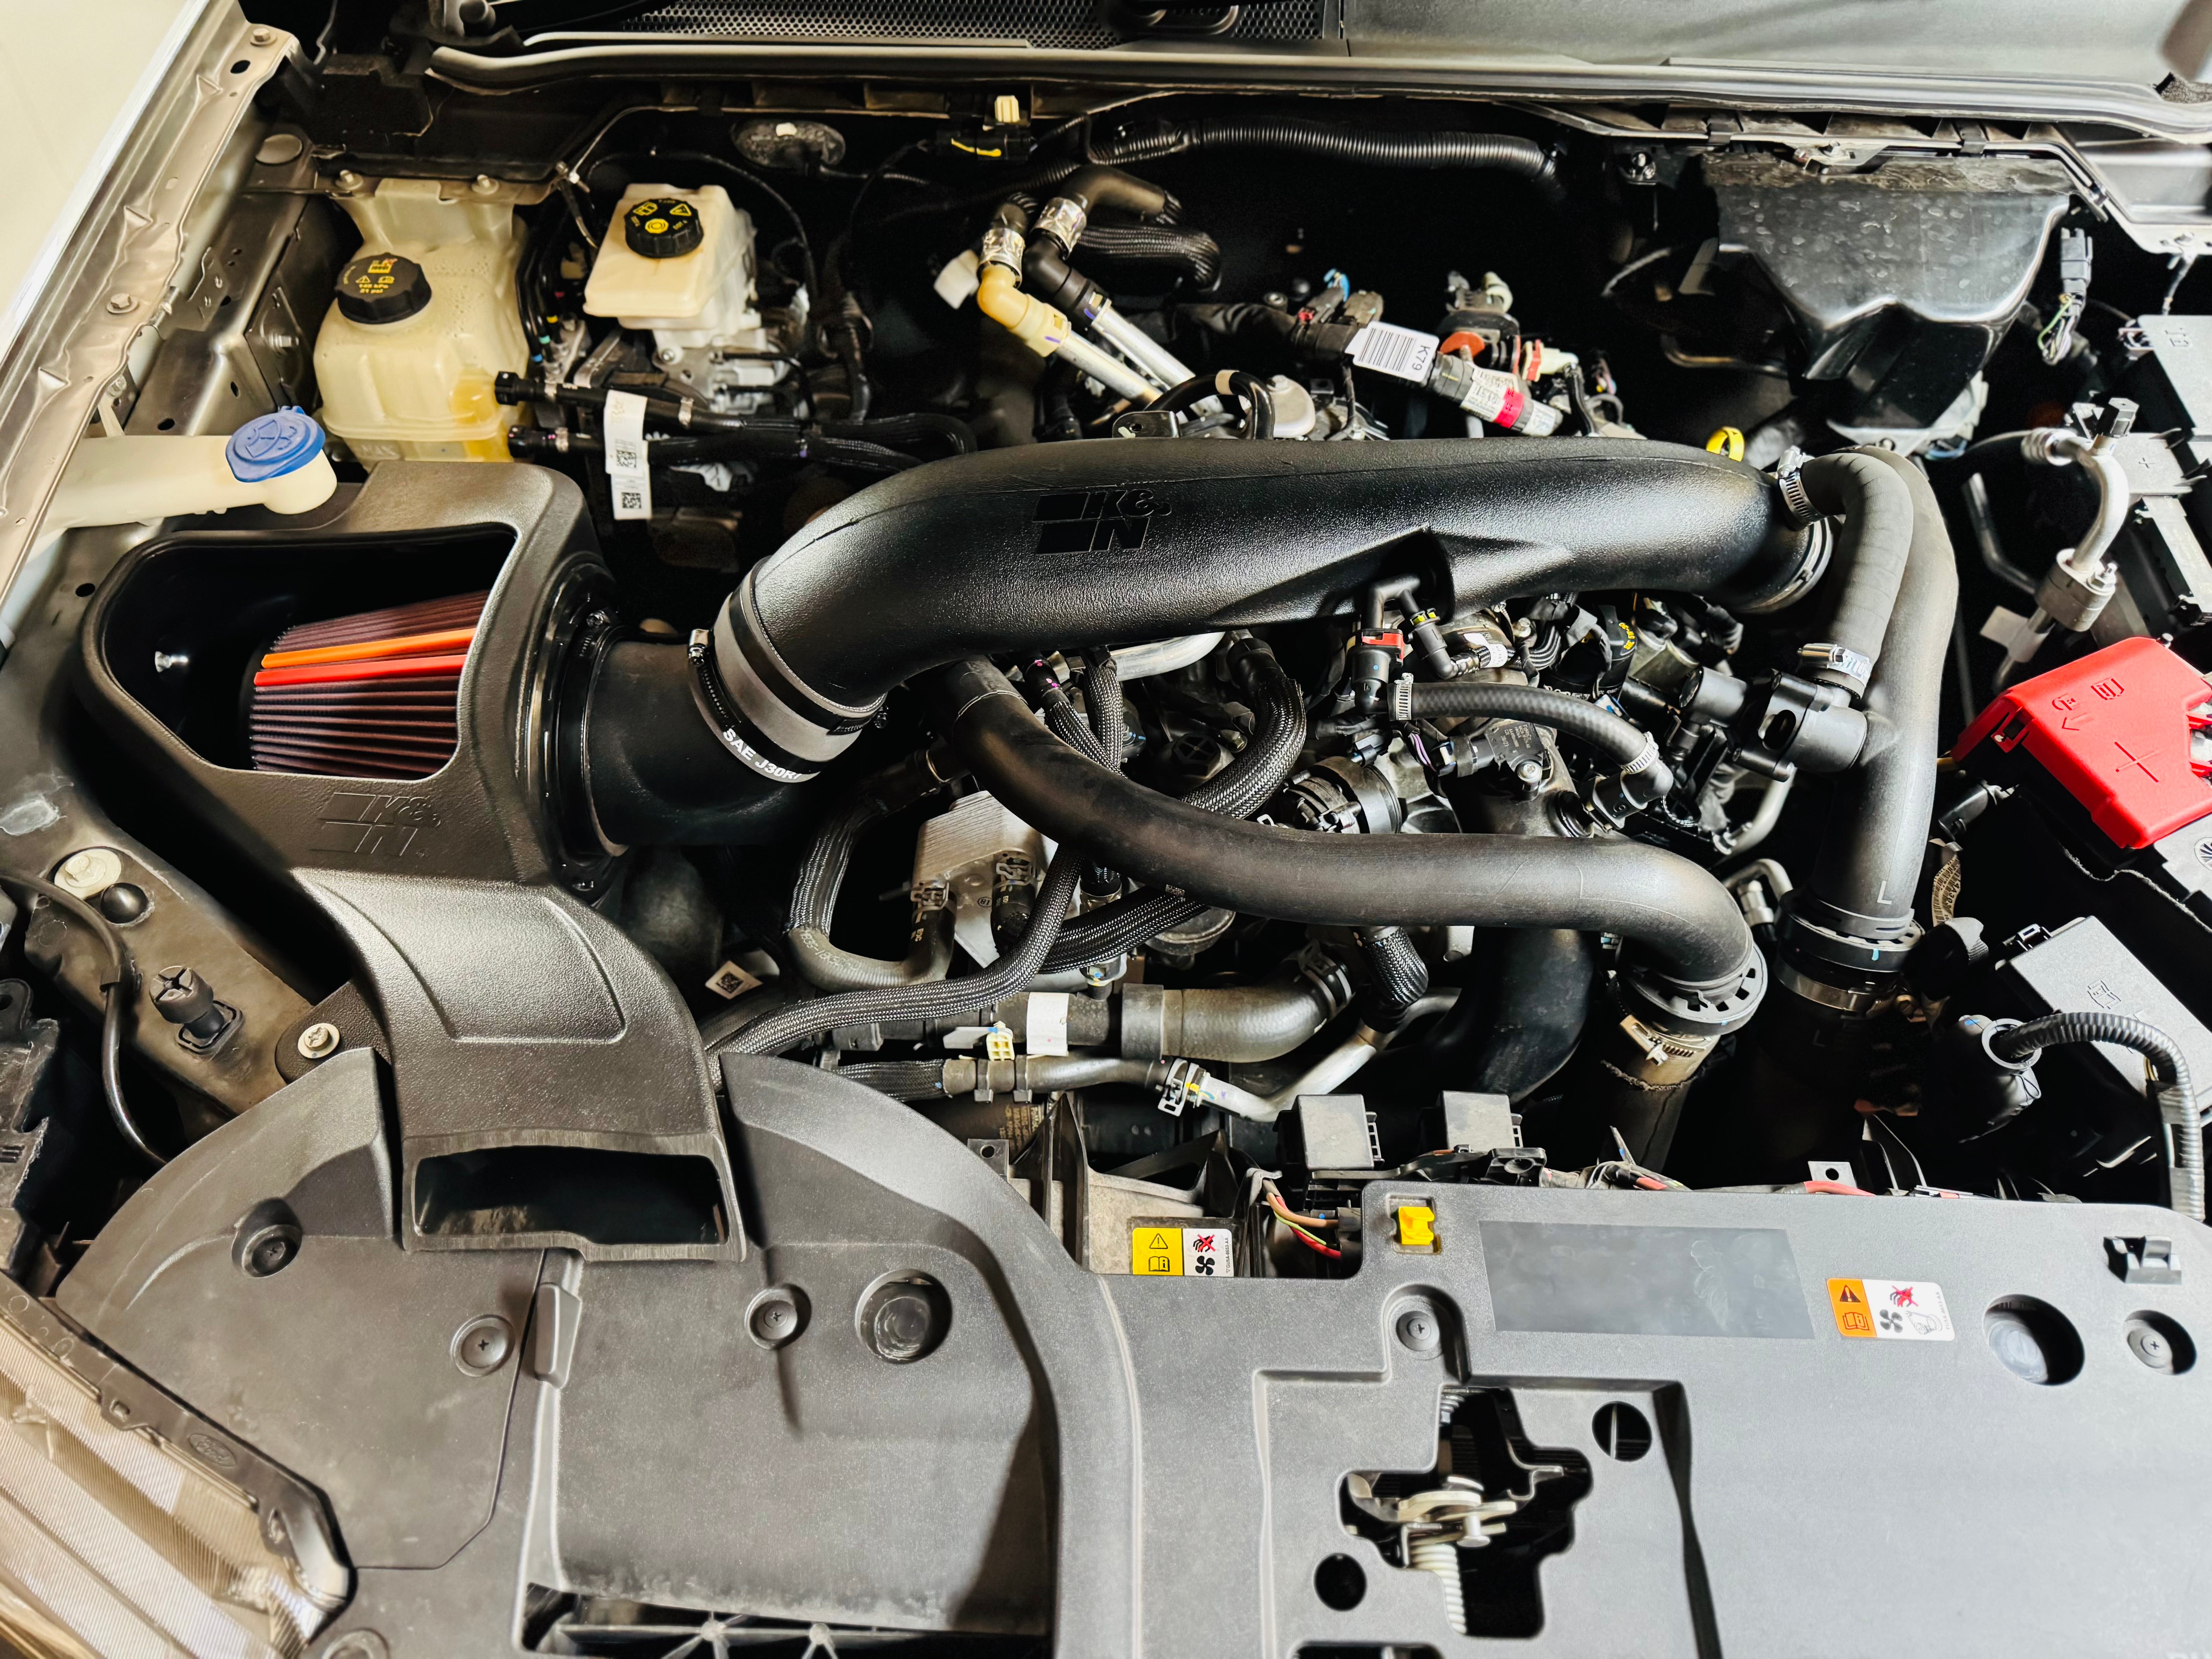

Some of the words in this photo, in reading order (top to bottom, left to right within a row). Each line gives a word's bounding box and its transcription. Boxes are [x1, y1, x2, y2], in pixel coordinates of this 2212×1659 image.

[1412, 345, 1431, 371] K79
[723, 728, 756, 761] SAE
[1877, 880, 1893, 905] L
